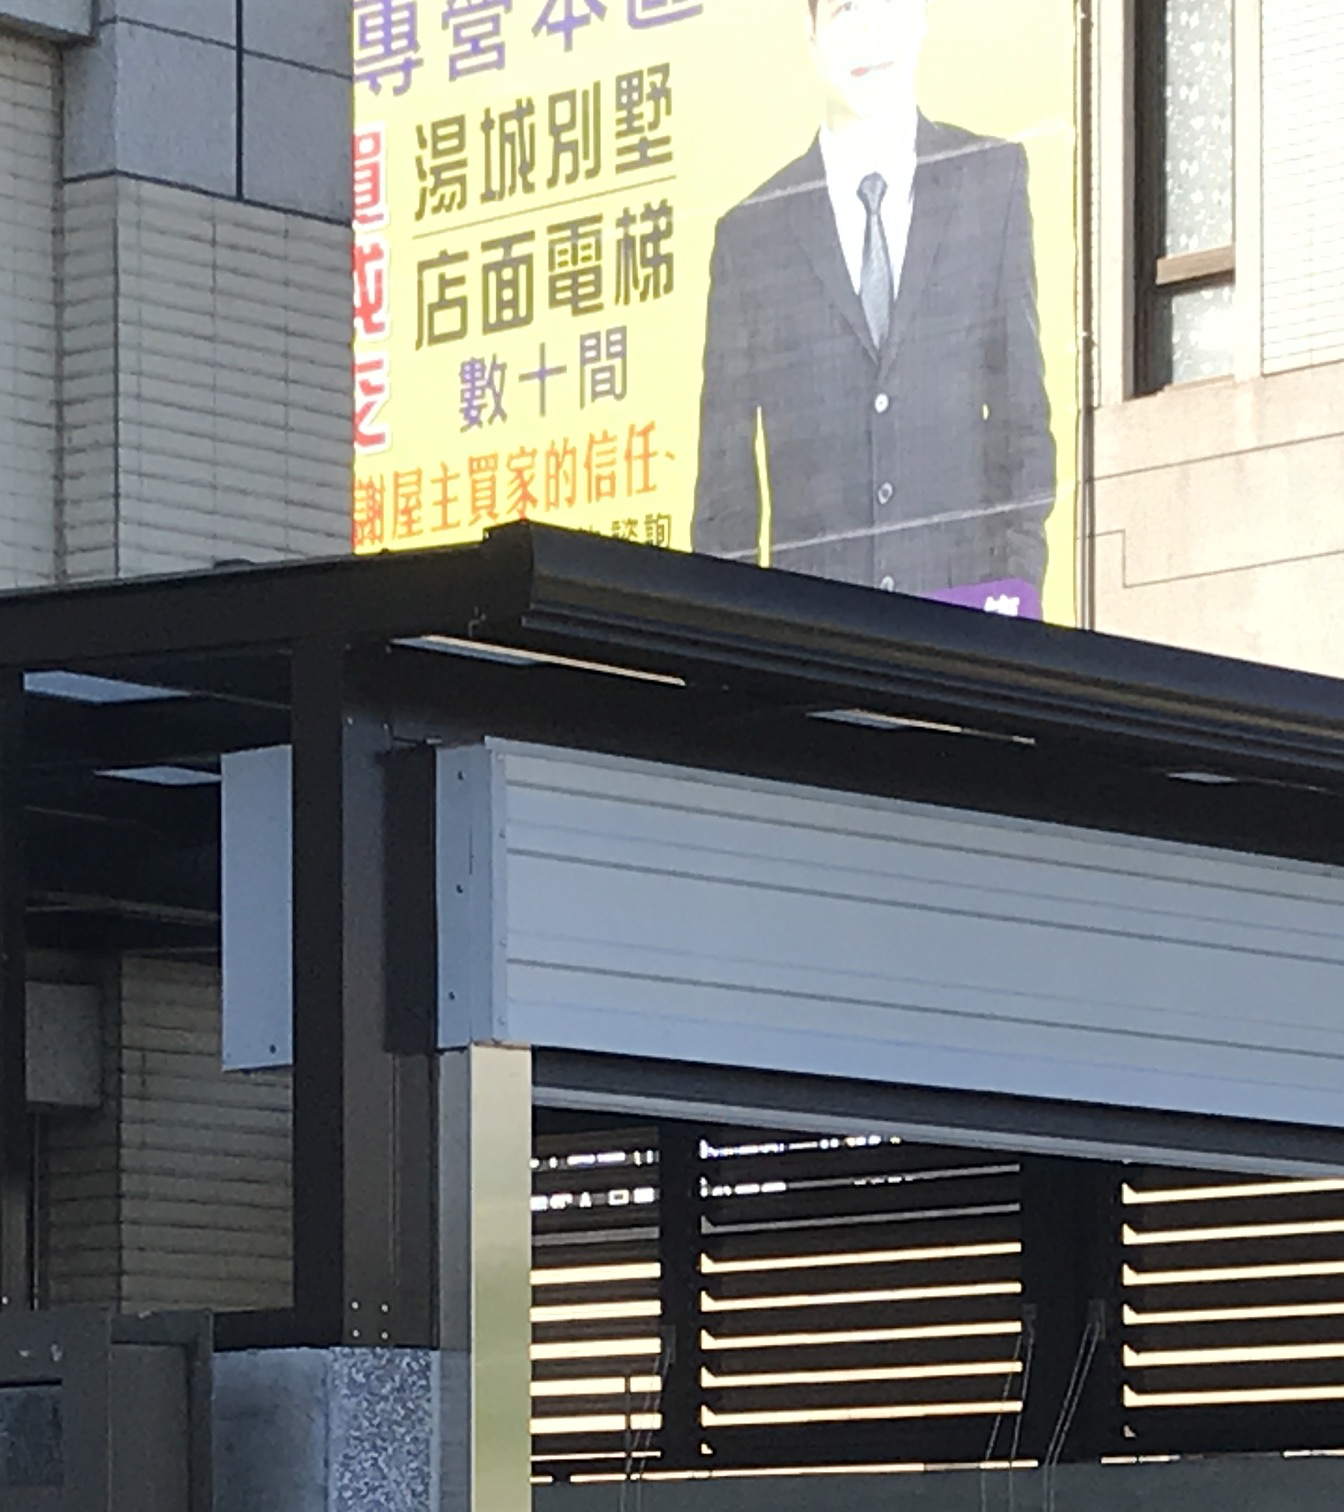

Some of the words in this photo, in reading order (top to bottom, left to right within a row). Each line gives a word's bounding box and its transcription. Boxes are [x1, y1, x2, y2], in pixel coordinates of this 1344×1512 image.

[415, 63, 673, 221] 湯城別墅
[416, 199, 674, 351] 店面電梯
[458, 325, 628, 433] 數十間
